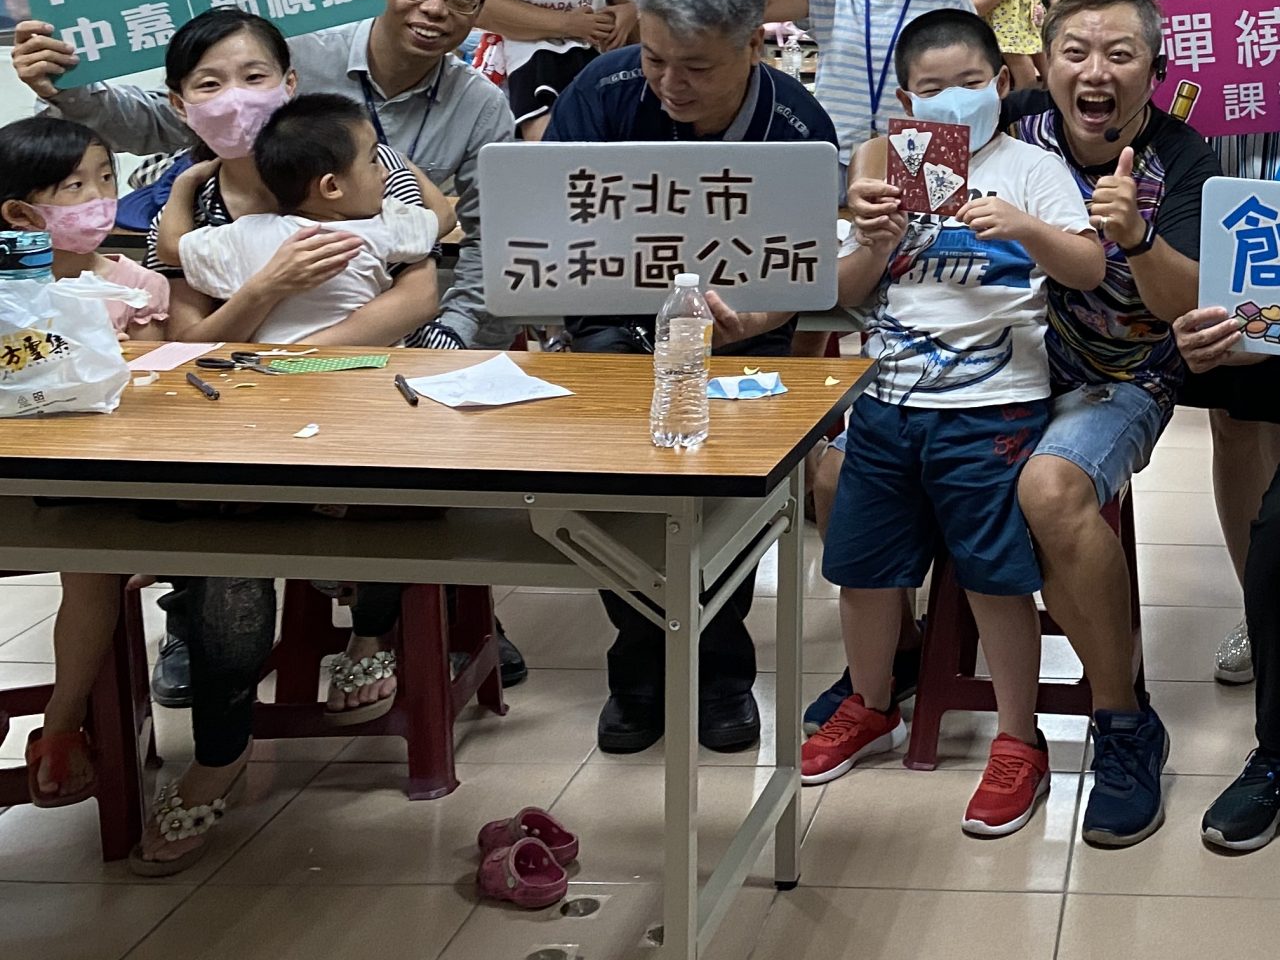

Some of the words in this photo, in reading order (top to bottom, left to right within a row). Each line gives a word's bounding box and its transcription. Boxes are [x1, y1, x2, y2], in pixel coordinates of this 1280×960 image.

[61, 2, 177, 62] 中嘉
[566, 168, 753, 223] 新北市
[503, 235, 818, 290] 永和區公所
